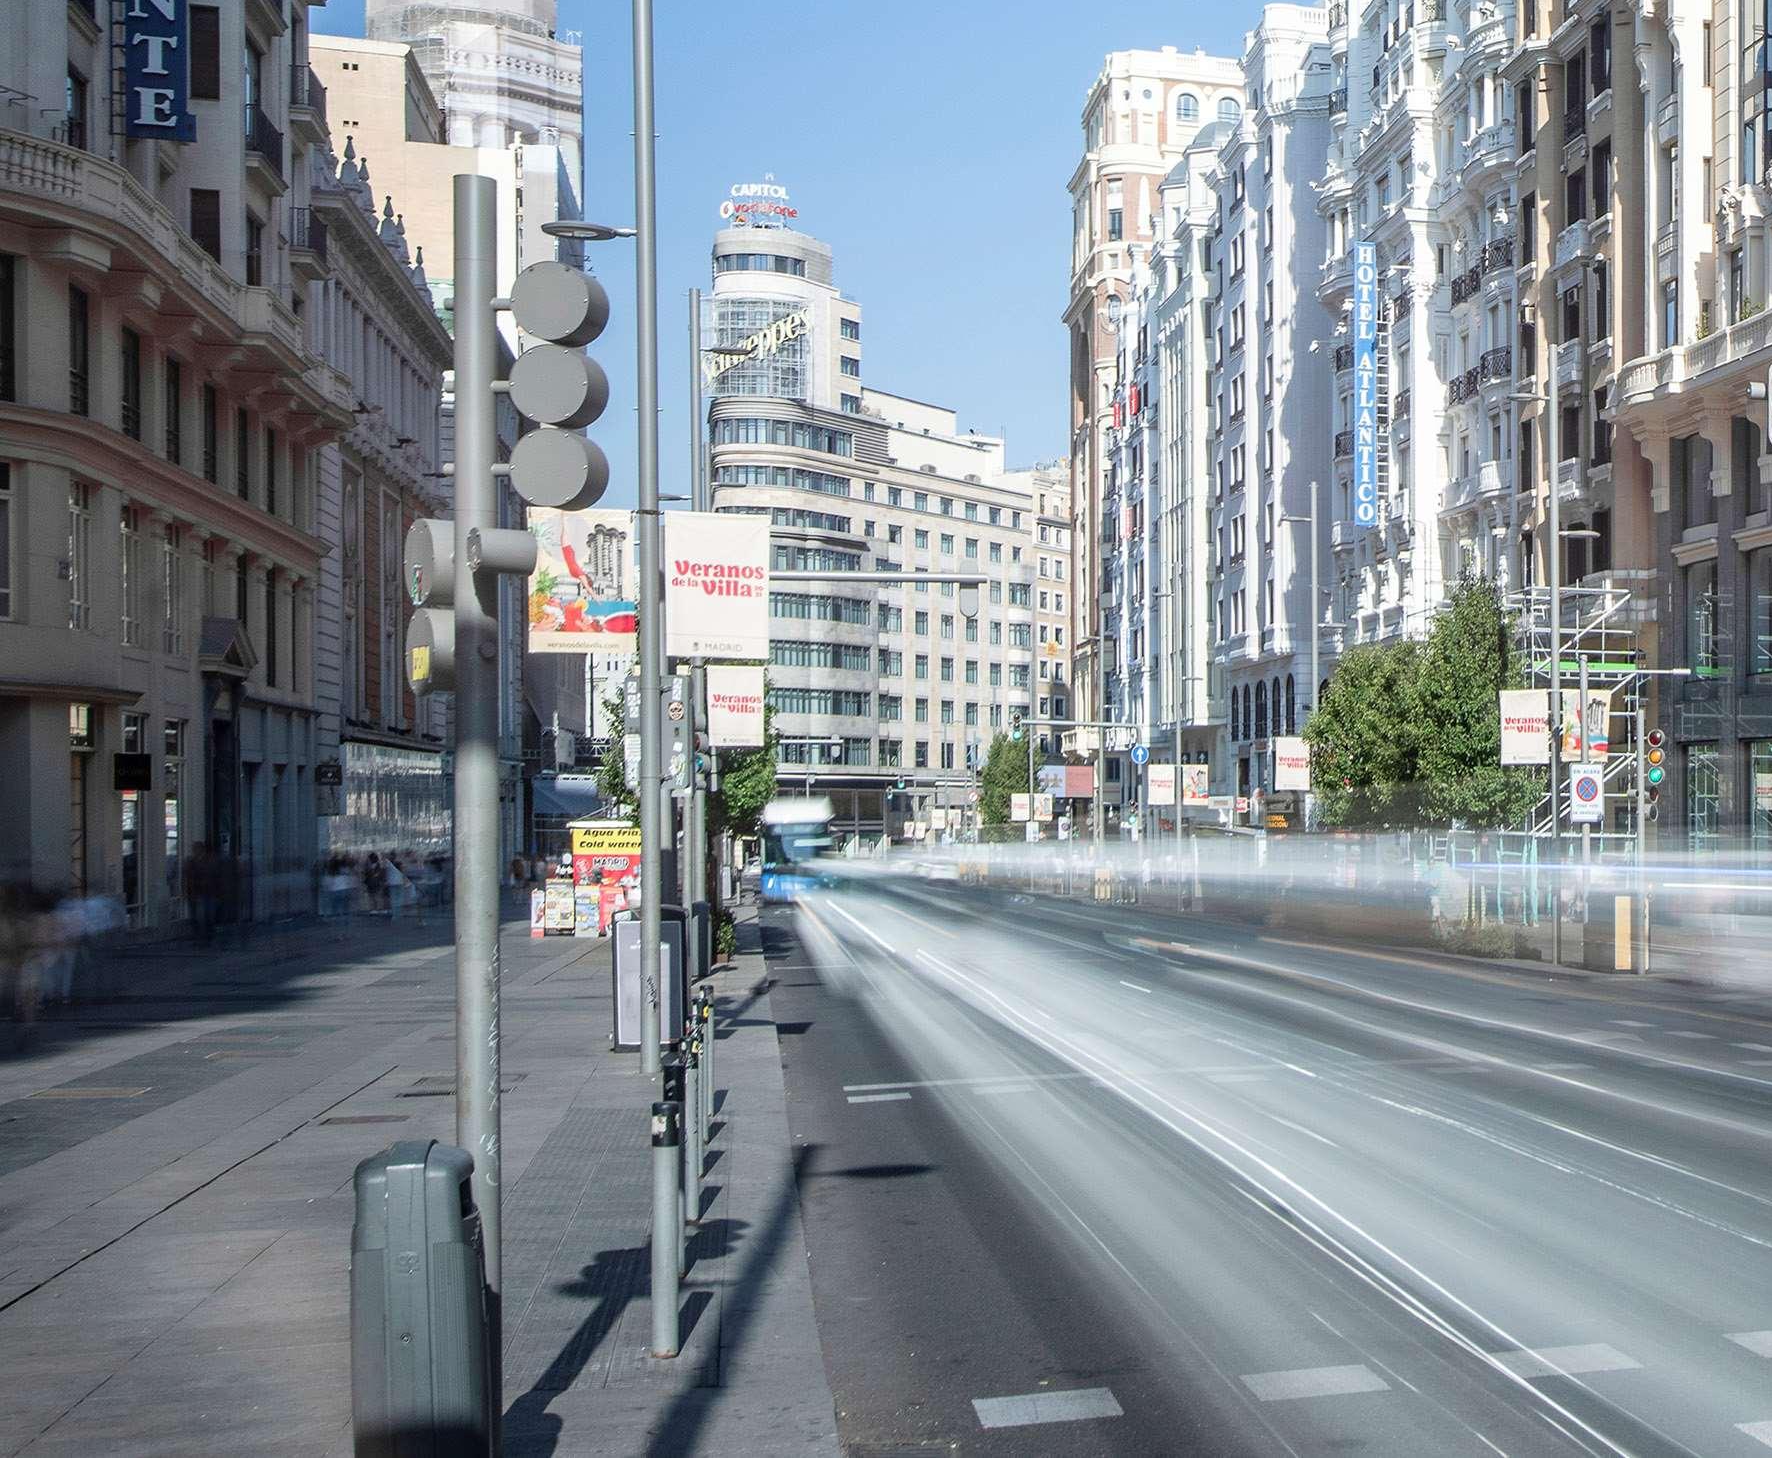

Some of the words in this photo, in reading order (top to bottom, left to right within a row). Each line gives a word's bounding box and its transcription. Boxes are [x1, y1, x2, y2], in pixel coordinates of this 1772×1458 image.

[730, 183, 790, 200] CAPITOL
[734, 201, 798, 219] vodafone
[1357, 246, 1375, 340] HOTEL
[1357, 351, 1375, 521] ATLANTICO
[675, 560, 764, 580] Veranos
[672, 577, 686, 587] de
[687, 577, 698, 587] la
[702, 579, 752, 597] Villa
[704, 642, 743, 652] MADRID
[713, 694, 763, 703] Veranos
[727, 704, 755, 713] Villa
